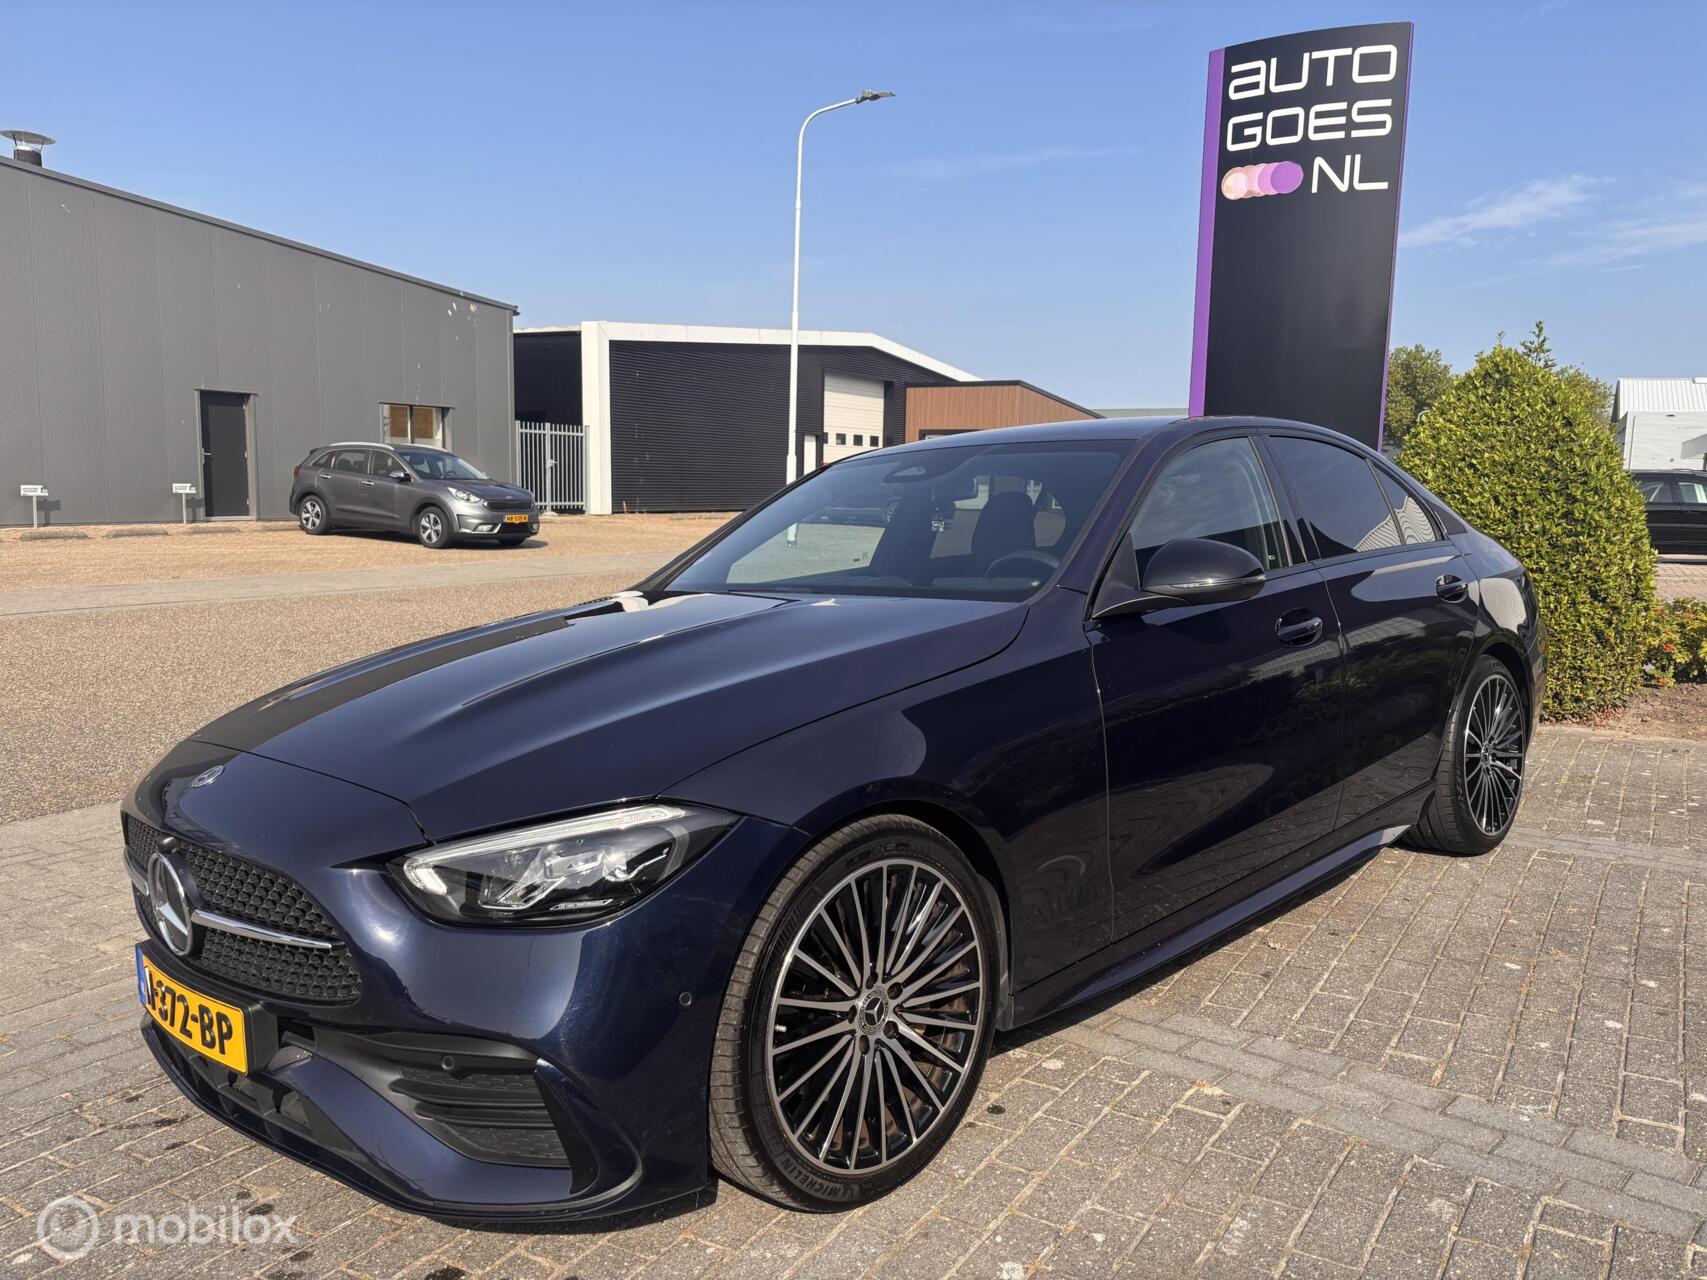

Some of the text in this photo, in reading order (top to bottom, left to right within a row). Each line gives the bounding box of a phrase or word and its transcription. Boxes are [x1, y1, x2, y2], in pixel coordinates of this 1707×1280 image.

[1226, 98, 1393, 152] GOES
[1311, 154, 1389, 194] NL
[780, 1158, 842, 1198] MICHELIN
